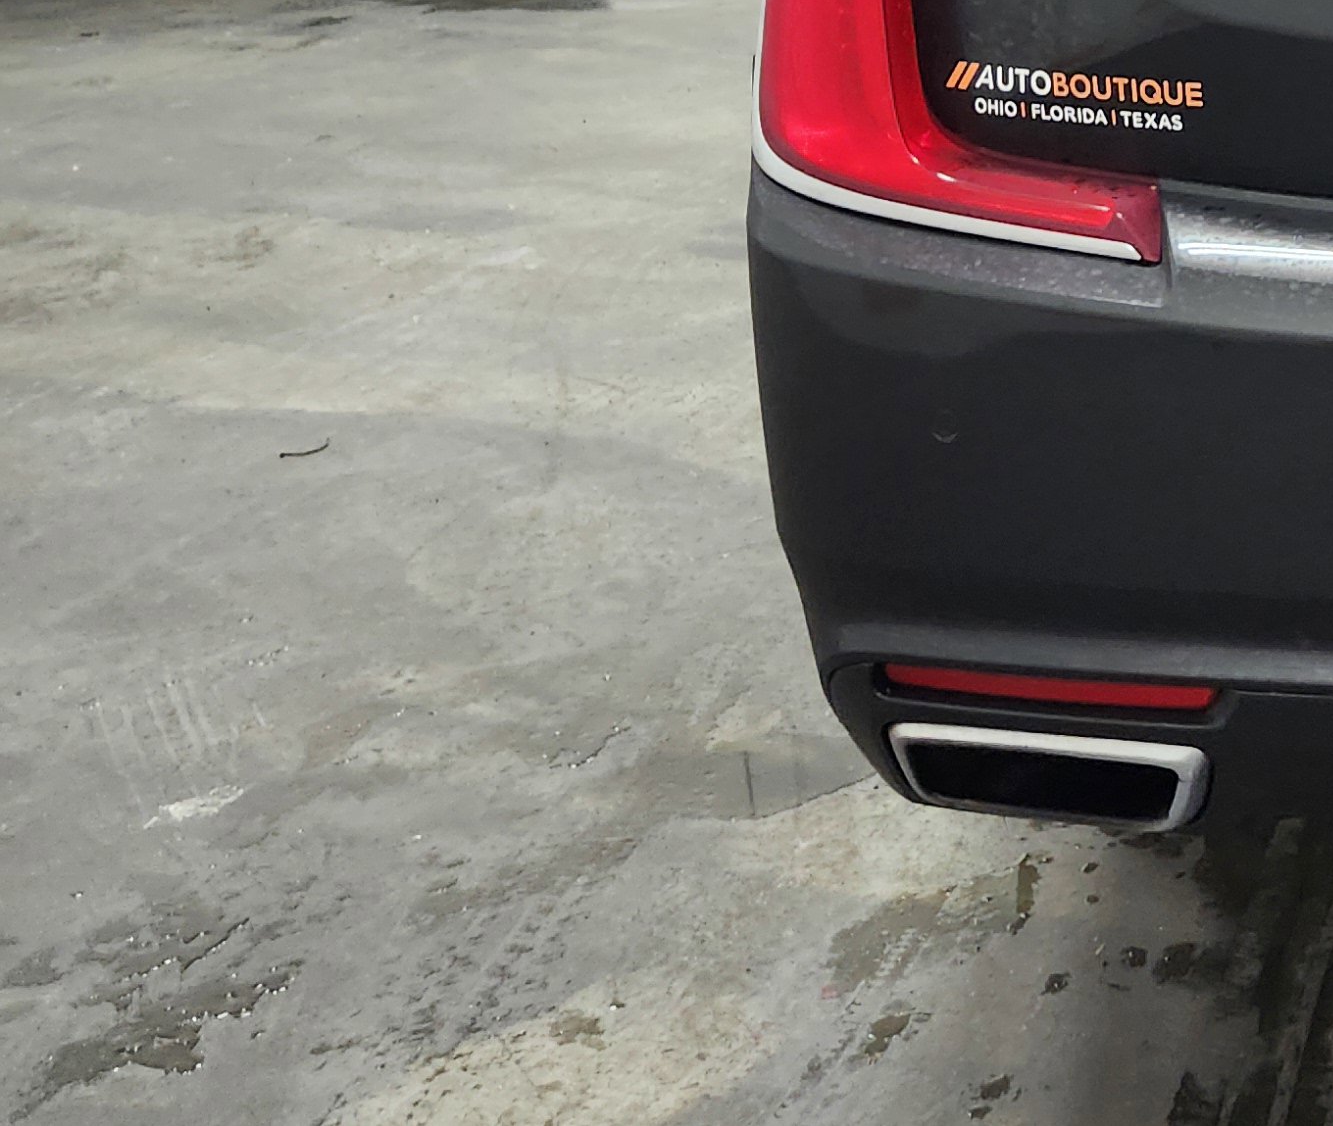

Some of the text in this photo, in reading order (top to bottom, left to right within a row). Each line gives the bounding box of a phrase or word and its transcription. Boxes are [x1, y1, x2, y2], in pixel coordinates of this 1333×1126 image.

[974, 64, 1204, 107] AUTOBOUTIQUE
[974, 98, 1184, 131] OHIO FLORIDA TEXAS
